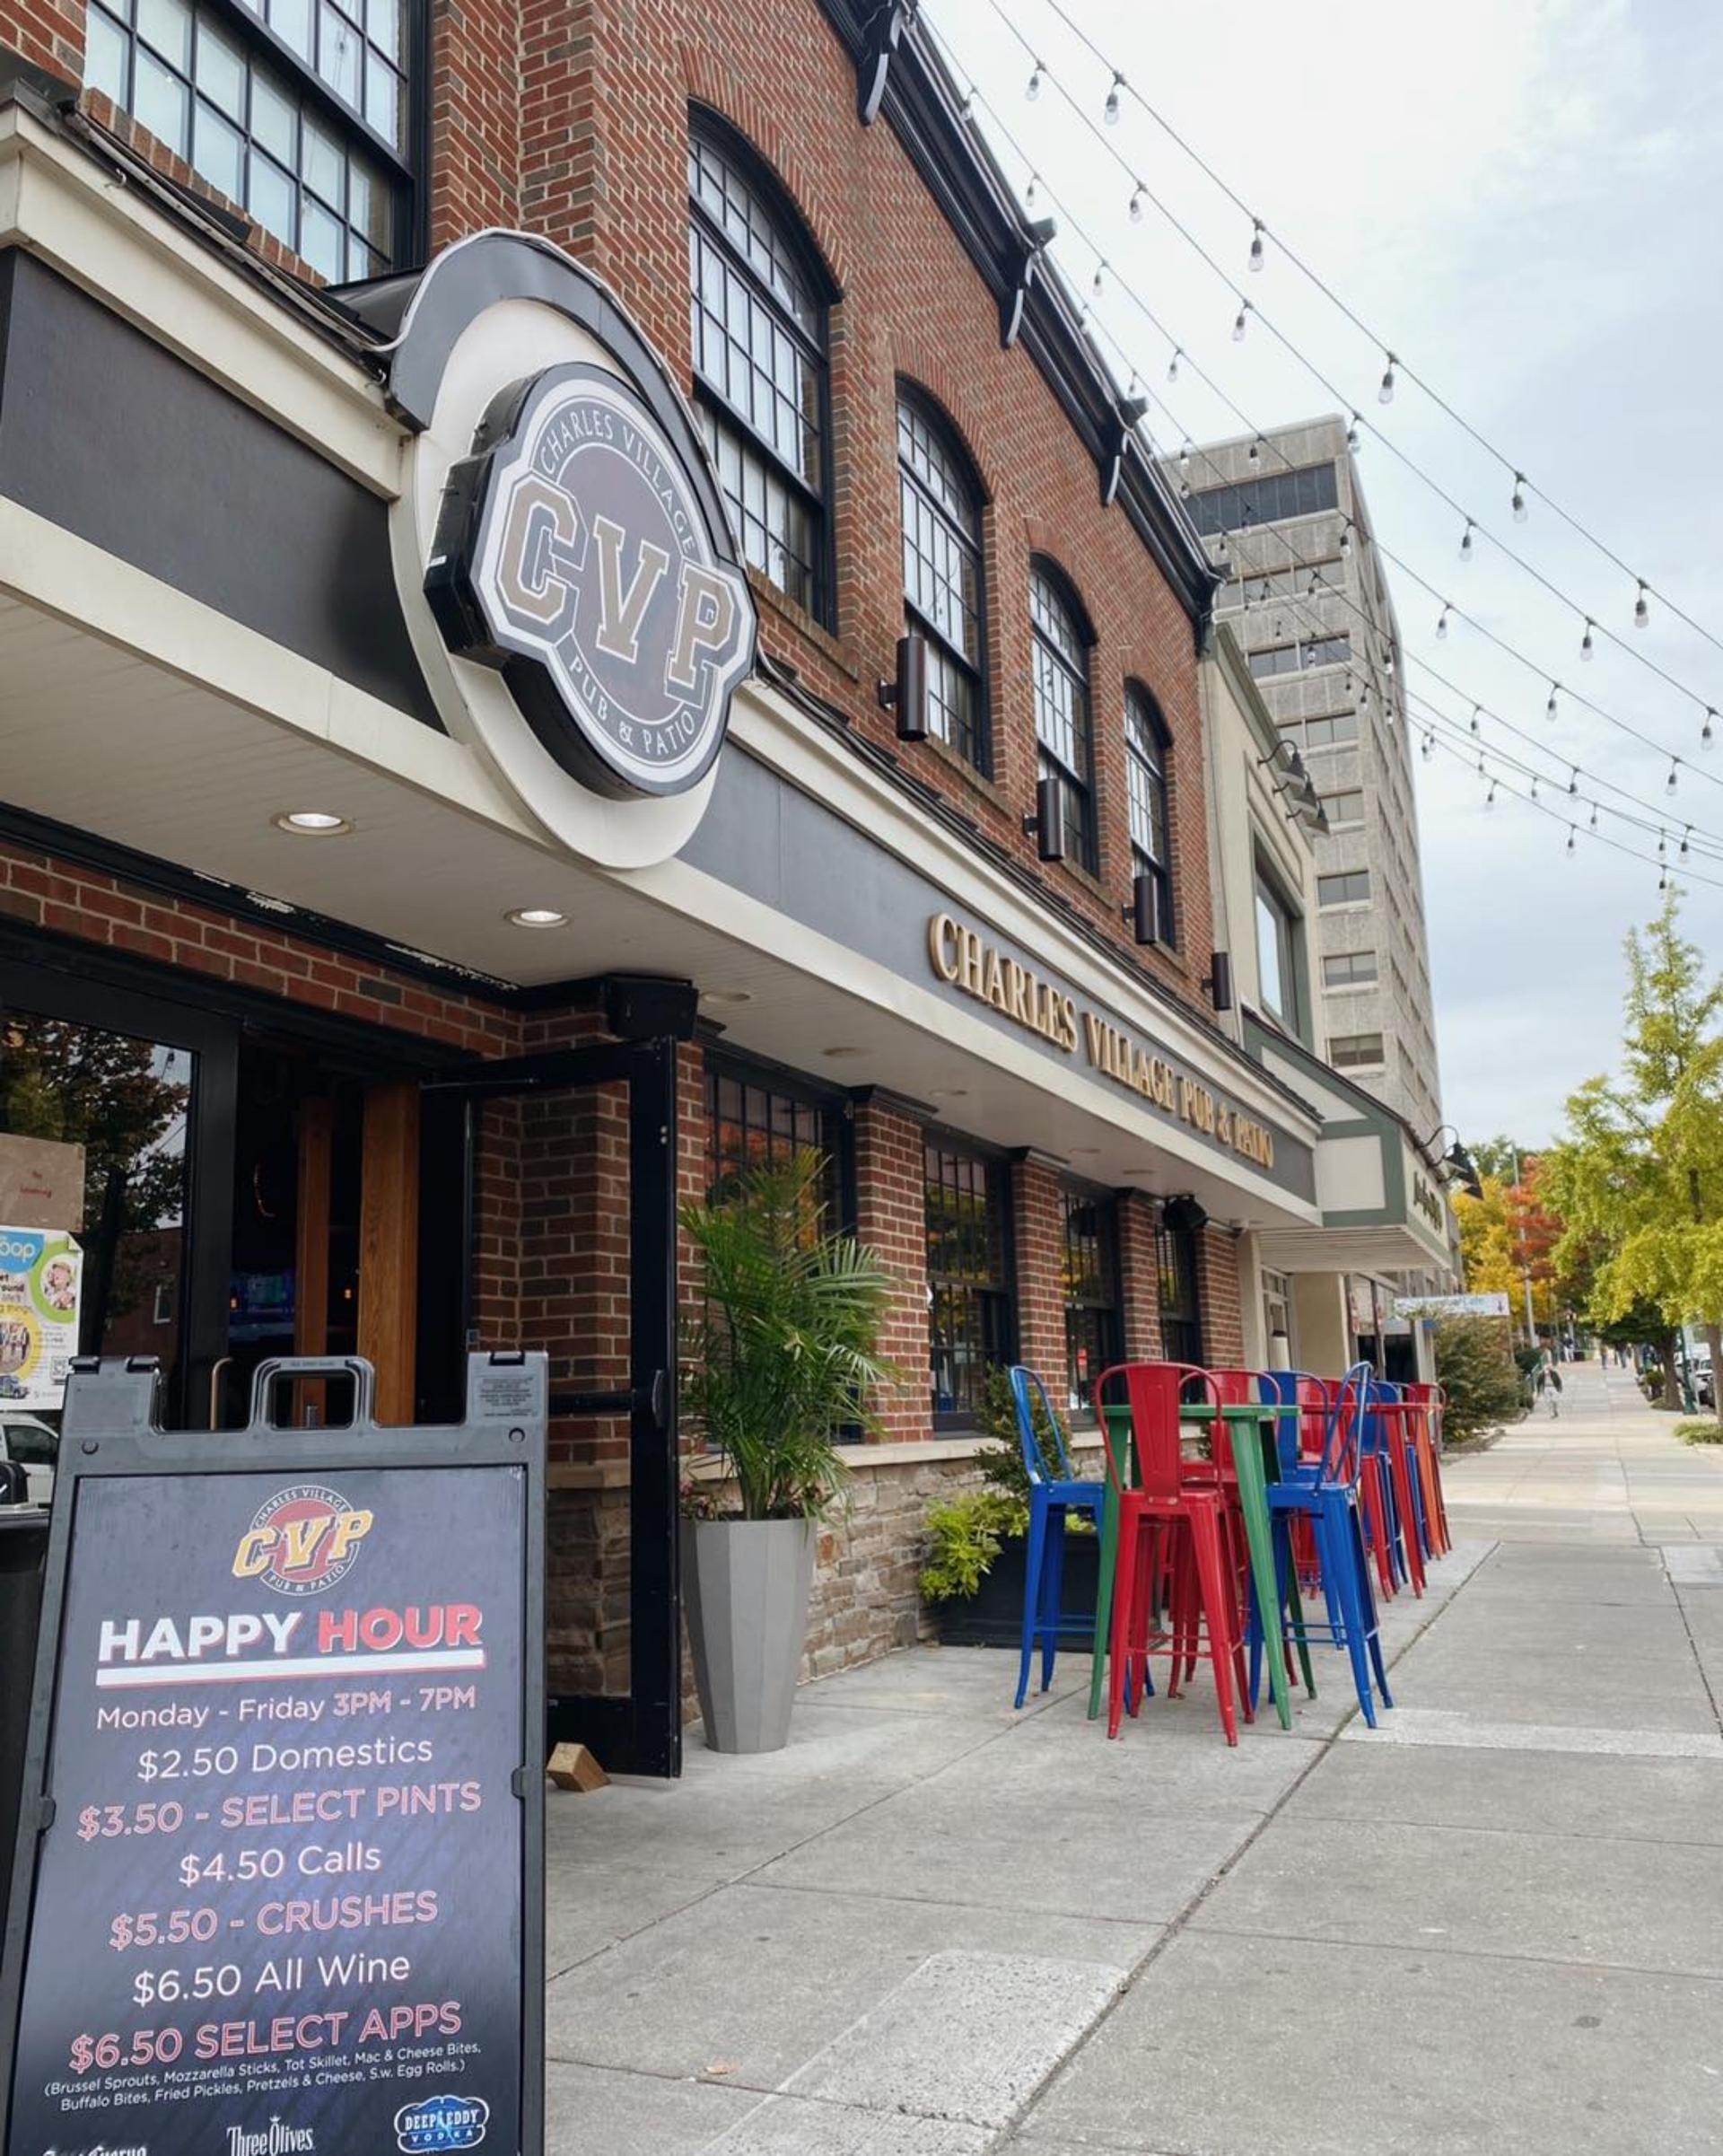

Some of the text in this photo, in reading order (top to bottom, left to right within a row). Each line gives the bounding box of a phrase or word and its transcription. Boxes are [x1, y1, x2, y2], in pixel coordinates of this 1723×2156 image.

[539, 408, 695, 553] CHARLES VILLAGE
[495, 472, 735, 689] CVP
[569, 658, 695, 756] PUB & PATIO
[928, 913, 1273, 1169] CHARLES VILLAGE PUB & PATIO
[255, 1488, 346, 1528] CHARLES VILLAGE
[232, 1509, 373, 1578] CVP
[268, 1573, 292, 1591] PUB
[310, 1564, 345, 1591] PATIO
[98, 1605, 483, 1662] HAPPY HOUR
[96, 1705, 210, 1731] Monday
[238, 1694, 326, 1722] Friday
[333, 1691, 392, 1717] 3PM
[418, 1685, 477, 1712] 7PM
[137, 1735, 433, 1783] $2.50 Domestics
[76, 1801, 184, 1843] $3.50
[220, 1787, 365, 1829] SELECT
[377, 1782, 483, 1817] PINTS
[179, 1841, 382, 1888] $4.50 Calls
[109, 1908, 218, 1951] $5.50
[256, 1889, 439, 1936] CRUSHES
[132, 1951, 411, 2008] $6.50 All Wine
[68, 2002, 463, 2074] $6.50 SELECT APPS
[44, 2078, 101, 2098] (Brussel
[104, 2073, 161, 2091] Sprouts,
[163, 2064, 236, 2084] Mozzarella
[239, 2059, 281, 2076] Sticks,
[284, 2059, 305, 2072] Tot
[309, 2054, 351, 2071] Skillet,
[354, 2051, 381, 2064] Mac
[384, 2049, 394, 2062] &
[397, 2046, 444, 2061] Cheese
[60, 2094, 111, 2112] Buffalo
[114, 2090, 151, 2107] Bites,
[154, 2087, 191, 2102] Fried
[194, 2082, 243, 2097] Pickles,
[247, 2075, 300, 2092] Pretzels
[302, 2074, 311, 2088] &
[315, 2070, 367, 2085] Cheese,
[397, 2064, 423, 2079] Egg
[425, 2058, 467, 2074] Rolls.)
[225, 2122, 314, 2156] Three Olives
[404, 2108, 480, 2132] DEEP EDDY
[410, 2129, 475, 2144] VODKA
